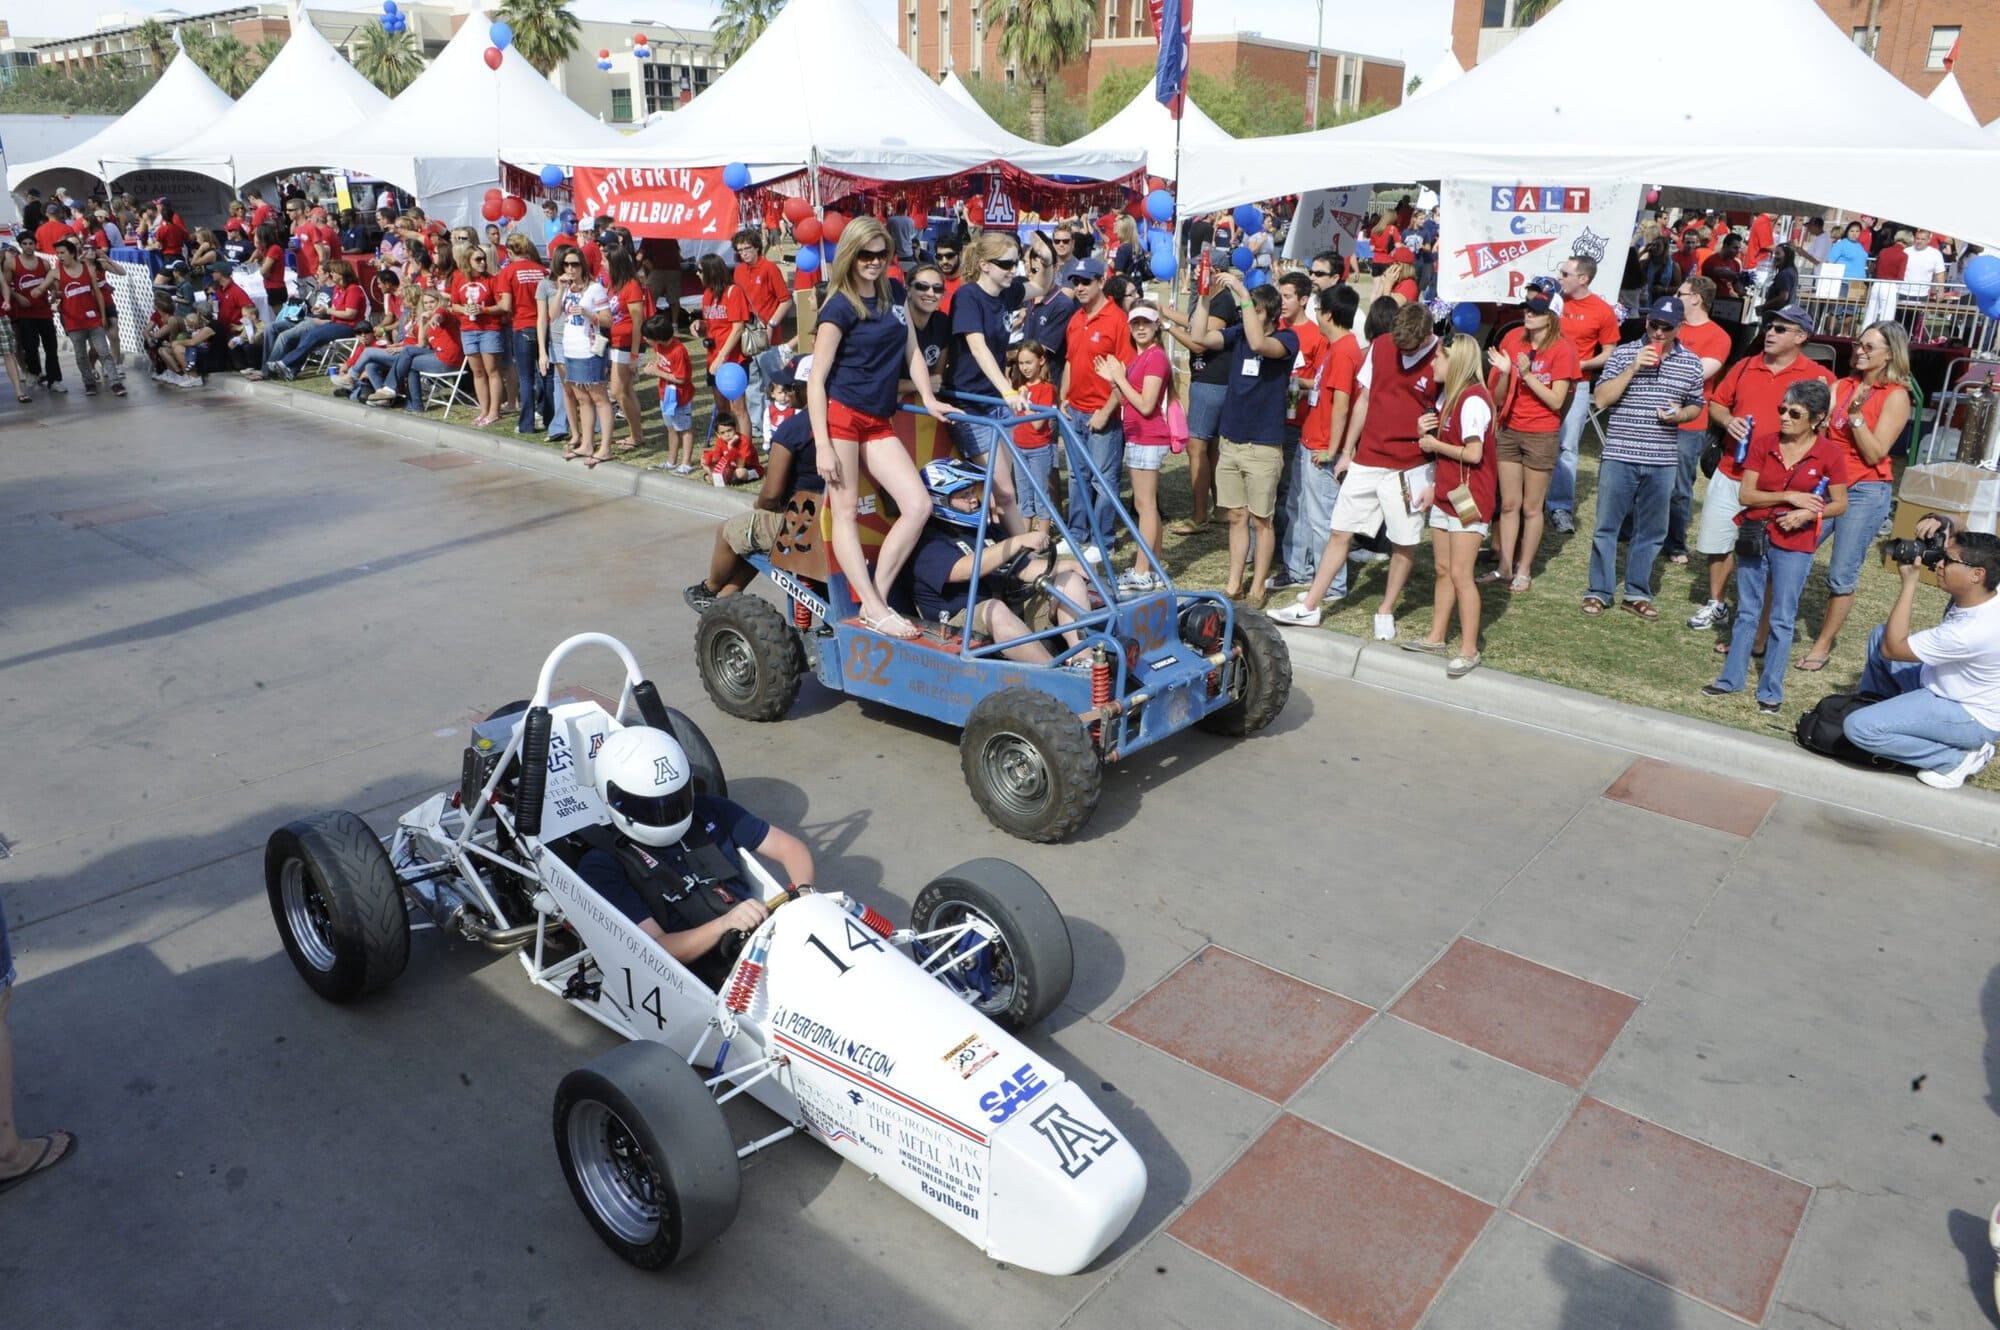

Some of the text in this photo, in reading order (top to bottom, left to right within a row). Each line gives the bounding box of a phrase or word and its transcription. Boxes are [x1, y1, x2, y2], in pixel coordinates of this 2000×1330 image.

[1494, 187, 1587, 212] SALT
[1510, 215, 1569, 235] Center
[1475, 240, 1529, 272] Aged
[772, 569, 825, 617] TOMCAR
[1133, 598, 1168, 657] 82
[845, 635, 895, 687] 82
[899, 647, 988, 684] The University
[908, 679, 974, 705] ARIZONA
[654, 756, 679, 785] A
[554, 796, 577, 808] TUBE
[556, 801, 589, 818] SERVICE
[550, 866, 685, 995] THE UNIVERSITY OF ARIZONA
[804, 917, 886, 978] 14
[621, 967, 668, 1031] 14
[979, 1062, 1048, 1124] SAE
[867, 1113, 983, 1182] THE METAL MAN
[1030, 1103, 1117, 1179] A
[899, 1148, 943, 1177] INDUSTRIAL
[967, 1183, 981, 1195] DIE
[921, 1180, 979, 1220] Raytheon
